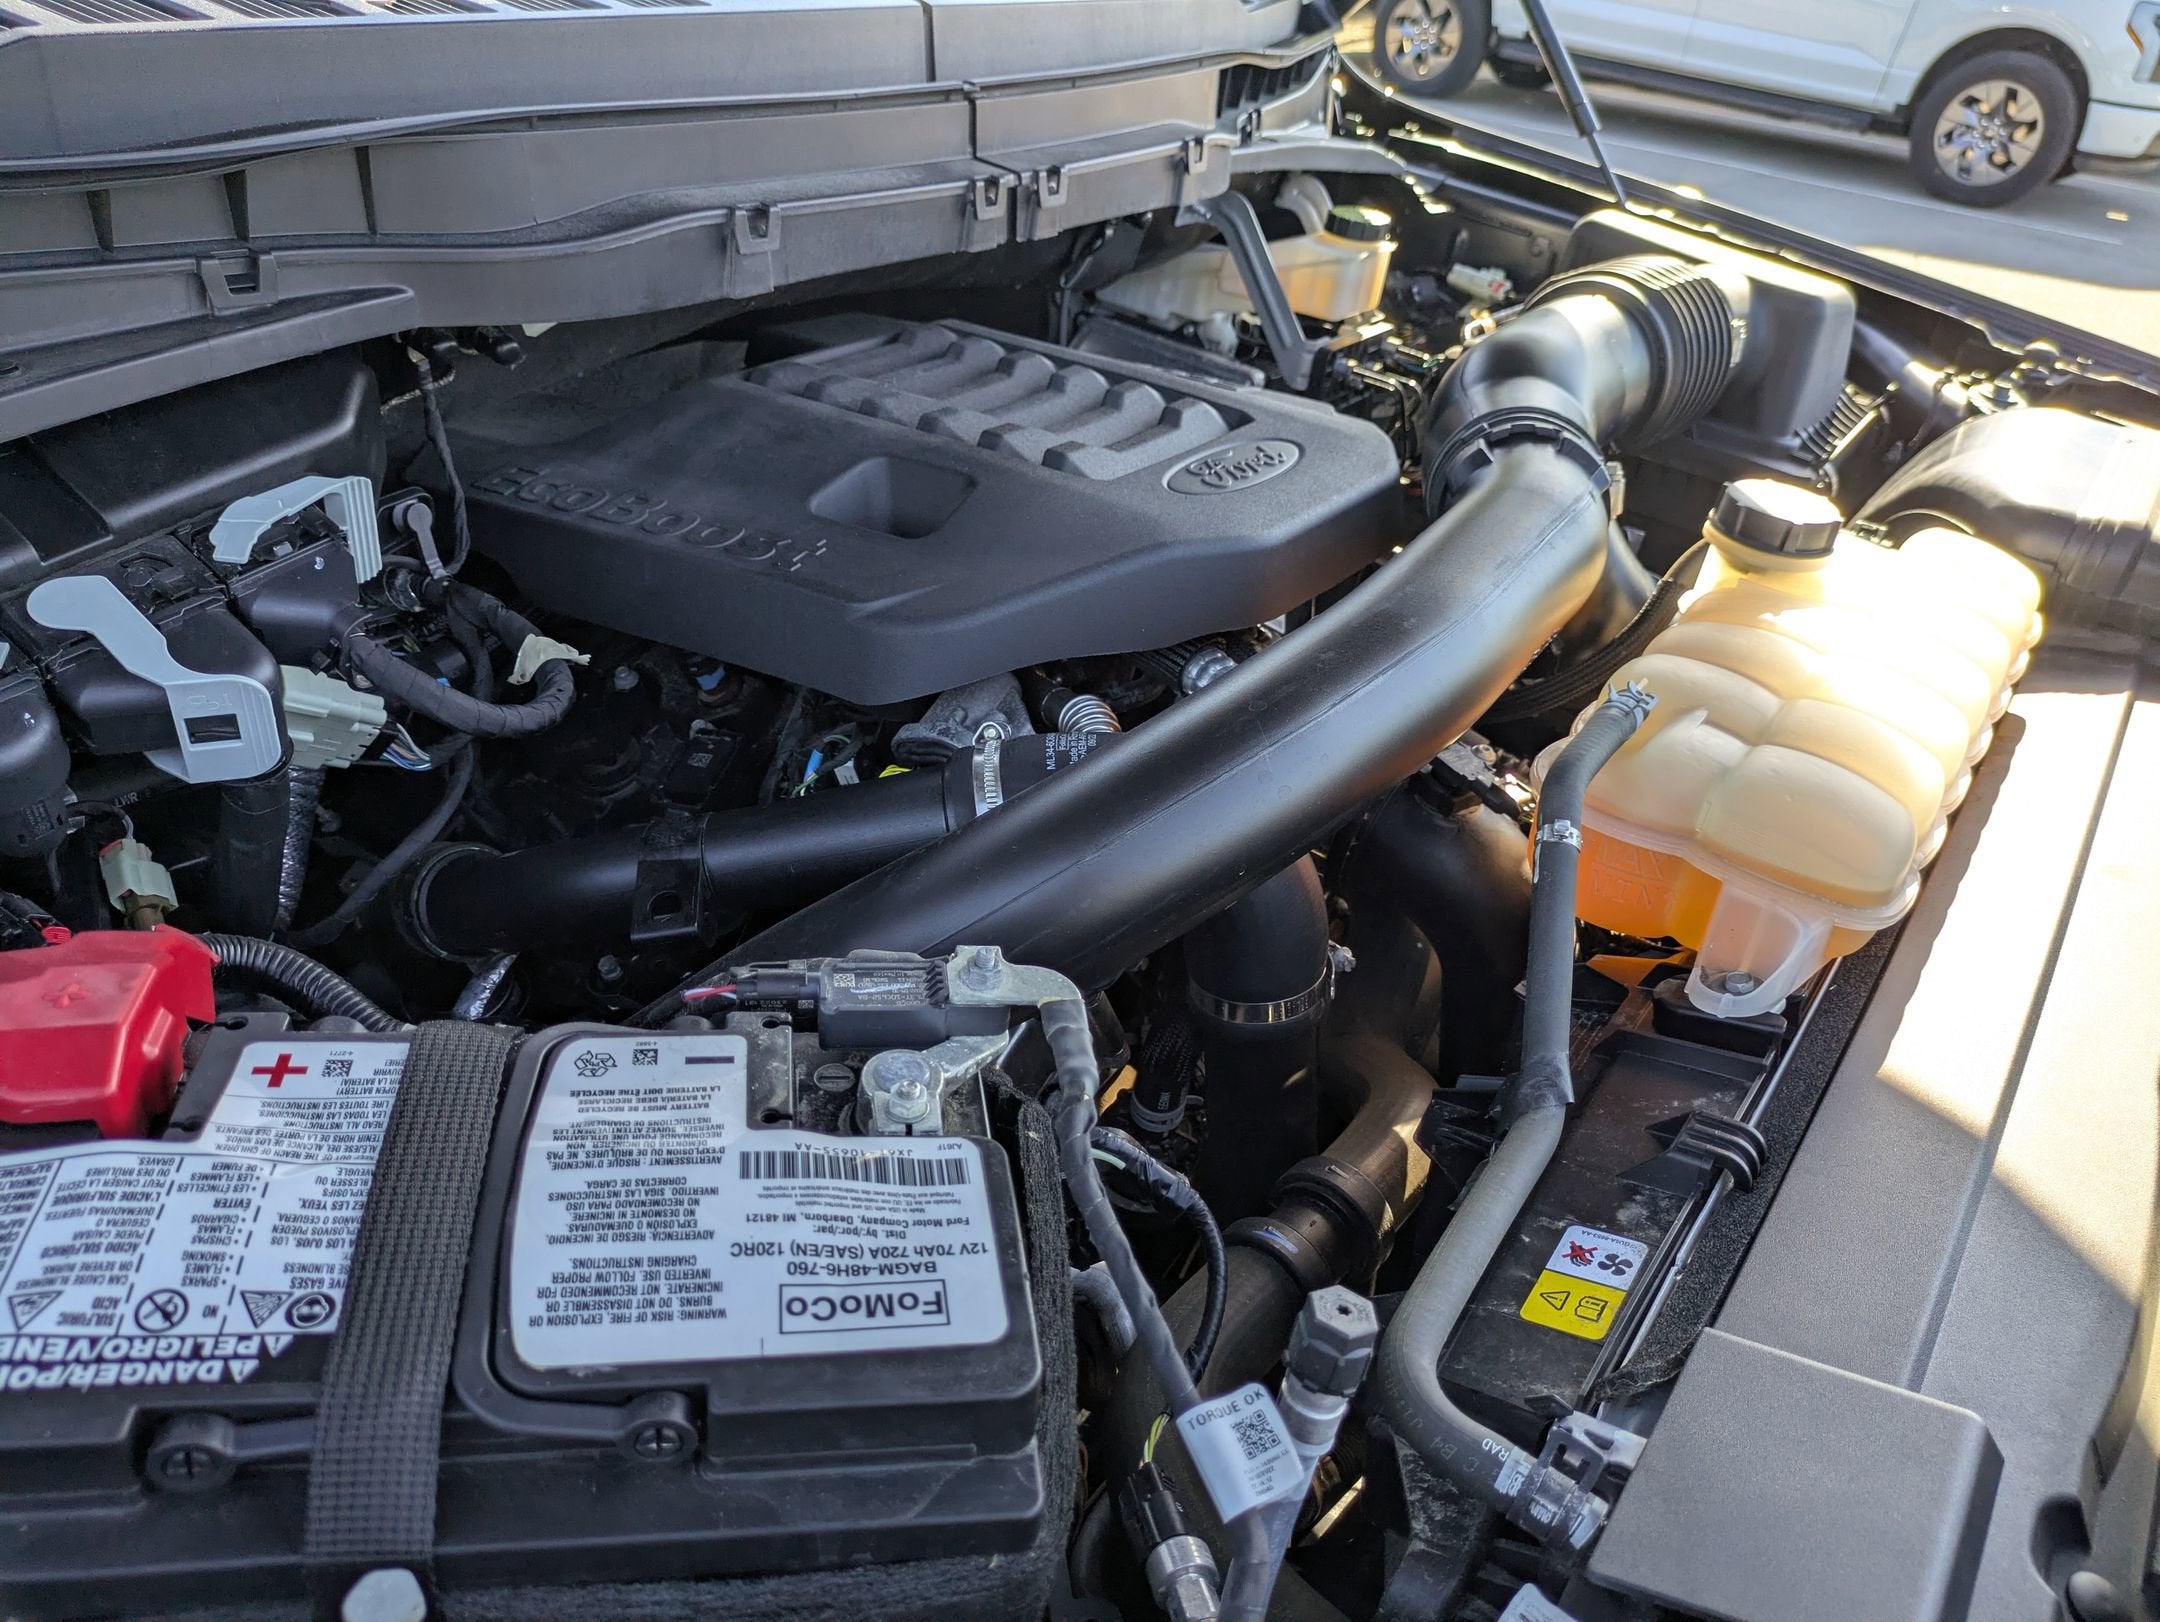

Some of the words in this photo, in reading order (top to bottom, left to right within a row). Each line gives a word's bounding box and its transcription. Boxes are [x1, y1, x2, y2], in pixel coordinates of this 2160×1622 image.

[1186, 445, 1287, 489] Ford
[337, 1087, 373, 1096] BATTERY!
[375, 1086, 396, 1095] OPEN
[643, 1088, 663, 1096] DOIT
[666, 1086, 708, 1094] BATTERIE
[339, 1101, 369, 1109] TOUTES
[372, 1100, 389, 1109] LIRE
[578, 1097, 633, 1106] RECICLARSE
[635, 1096, 658, 1104] DEBE
[323, 1101, 337, 1110] LES
[670, 1102, 709, 1111] BATTERY
[327, 1111, 341, 1120] LAS
[344, 1111, 369, 1120] TODAS
[372, 1110, 387, 1119] LEA
[346, 1121, 359, 1129] ALL
[362, 1121, 384, 1129] READ
[256, 1128, 272, 1136] DES
[645, 1127, 676, 1135] SUIVEZ
[307, 1134, 317, 1142] LA
[320, 1135, 330, 1143] DE
[333, 1135, 355, 1143] HORS
[358, 1135, 380, 1143] TENIR
[553, 1134, 608, 1142] UTILISATION
[611, 1134, 629, 1142] UNE
[632, 1132, 656, 1142] POUR
[273, 1140, 284, 1149] DE
[286, 1141, 322, 1152] ALCANCE
[326, 1144, 341, 1152] DEL
[567, 1141, 586, 1150] NON
[546, 1151, 563, 1160] PAS
[566, 1150, 578, 1159] NE
[635, 1148, 648, 1157] DE
[651, 1148, 663, 1157] OU
[607, 1158, 640, 1169] RISQUE
[649, 1155, 722, 1167] AVERTISSEMENT
[212, 1162, 243, 1171] FUMER
[246, 1164, 257, 1172] DE
[137, 1168, 155, 1176] DES
[157, 1168, 171, 1176] OU
[190, 1172, 235, 1181] FLAMMES
[238, 1173, 254, 1182] LES
[315, 1176, 328, 1185] OU
[331, 1177, 369, 1186] BLESSER
[620, 1178, 632, 1187] DE
[634, 1176, 687, 1187] CORRECTAS
[89, 1179, 100, 1188] LA
[103, 1178, 140, 1189] CAUSER
[142, 1178, 165, 1188] PEUT
[233, 1183, 250, 1192] LES
[584, 1179, 617, 1189] CARGA.
[548, 1190, 622, 1201] INSTRUCCIONES
[624, 1188, 641, 1199] LAS
[644, 1187, 664, 1198] SIGA
[669, 1186, 719, 1197] INVERTIDO.
[212, 1198, 252, 1211] ÉVITER
[332, 1201, 349, 1209] LES
[566, 1201, 585, 1211] USO
[588, 1200, 612, 1210] PARA
[615, 1197, 684, 1208] RECOMENDADO
[687, 1197, 700, 1206] NO
[88, 1207, 155, 1218] QUEMADURAS
[276, 1212, 320, 1223] CEGUERA.
[618, 1210, 627, 1220] NI
[630, 1208, 680, 1219] DESMONTE
[683, 1208, 696, 1218] NO
[107, 1218, 150, 1227] CEGUERA
[190, 1214, 240, 1223] CIGARROS
[745, 1213, 779, 1223] 48121
[782, 1213, 796, 1223] MI
[800, 1212, 853, 1225] Dearborn,
[857, 1214, 909, 1228] Company,
[912, 1218, 943, 1228] Motor
[946, 1216, 969, 1226] Ford
[197, 1225, 235, 1234] FLAMAS
[272, 1224, 309, 1235] PUEDEN
[565, 1221, 634, 1232] QUEMADURAS.
[637, 1220, 644, 1230] O
[646, 1219, 698, 1231] EXPLOSIÓN
[72, 1230, 112, 1241] CAUSAR
[114, 1230, 145, 1240] PUEDE
[545, 1233, 594, 1245] INCENDIO,
[597, 1233, 608, 1243] DE
[611, 1231, 646, 1242] RIESGO
[649, 1229, 715, 1241] ADVERTENCIA:
[882, 1229, 906, 1239] Dist.
[191, 1235, 233, 1245] CHISPAS
[270, 1236, 289, 1245] LOS
[294, 1237, 323, 1247] OJOS.
[327, 1238, 345, 1247] LOS
[730, 1242, 784, 1256] 120RC
[790, 1240, 864, 1258] (SAE/EN)
[868, 1245, 907, 1258] 720A
[914, 1243, 954, 1256] 70Ah
[960, 1241, 987, 1255] 12V
[182, 1250, 228, 1261] SMOKING
[79, 1261, 117, 1271] SEVERE
[119, 1261, 133, 1270] OR
[568, 1257, 644, 1270] INSTRUCTIONS.
[647, 1255, 697, 1268] CHARGING
[184, 1263, 224, 1274] FLAMES
[283, 1263, 335, 1274] BLINDNESS
[787, 1260, 937, 1277] BAGM-48H6-760
[552, 1272, 592, 1284] PROPER
[595, 1271, 636, 1282] FOLLOW
[639, 1270, 661, 1281] USE.
[664, 1268, 711, 1280] INVERTED
[181, 1276, 219, 1287] SPARKS
[290, 1276, 324, 1289] GASES
[537, 1287, 557, 1298] FOR
[561, 1284, 638, 1297] RECOMMENDED
[640, 1284, 660, 1295] NOT
[664, 1281, 723, 1294] INCINERATE.
[92, 1296, 122, 1310] ACID
[546, 1301, 560, 1312] OR
[563, 1299, 633, 1311] DISASSEMBLE
[636, 1297, 656, 1309] NOT
[659, 1297, 672, 1308] DO
[676, 1295, 712, 1308] BURNS.
[786, 1290, 943, 1322] FoMoCo
[203, 1305, 219, 1318] NO
[677, 1308, 727, 1321] WARNING:
[528, 1316, 544, 1327] OR
[546, 1313, 603, 1326] EXPLOSION
[606, 1312, 632, 1324] FIRE,
[634, 1312, 648, 1323] OF
[651, 1311, 674, 1323] RISK
[1187, 1400, 1241, 1430] TORQUE
[1244, 1388, 1265, 1406] OK
[1482, 1438, 1510, 1462] RAD
